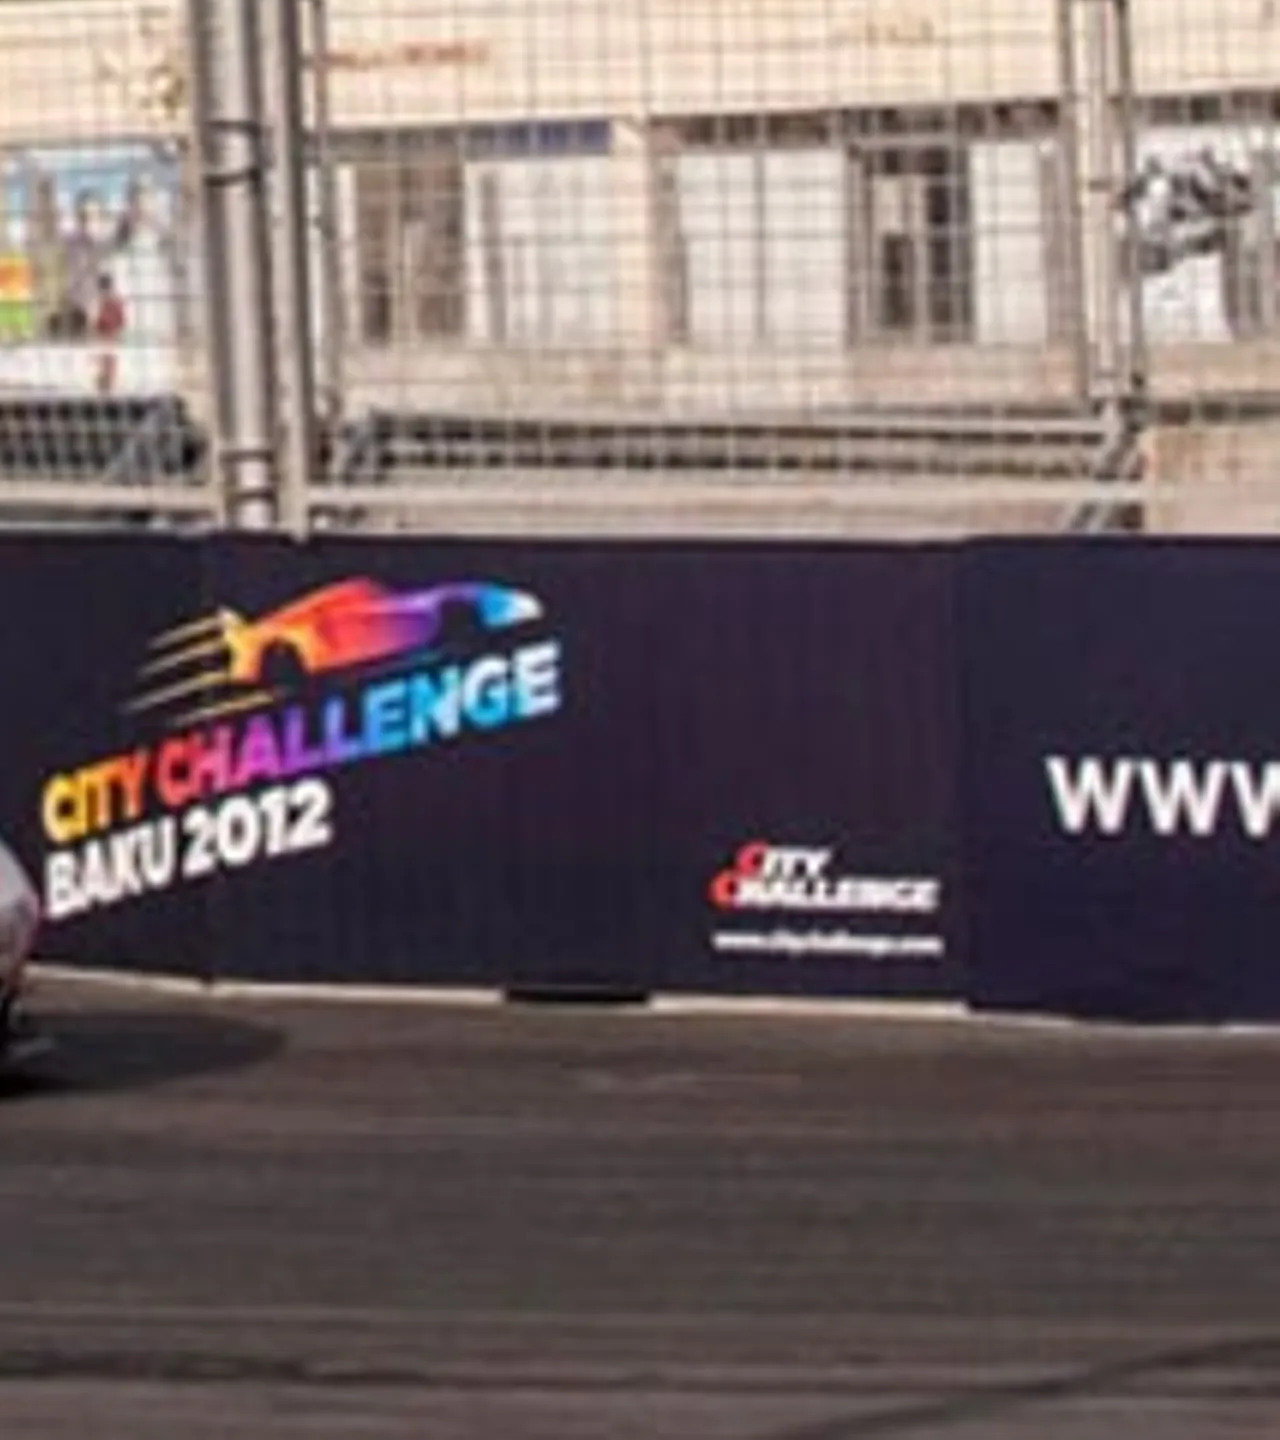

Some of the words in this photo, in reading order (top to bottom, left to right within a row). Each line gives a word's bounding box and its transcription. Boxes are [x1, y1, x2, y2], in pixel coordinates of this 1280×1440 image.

[42, 750, 149, 843] CITY
[154, 640, 562, 808] CHALLENGE
[43, 821, 178, 919] BAKU
[182, 779, 332, 878] 2012
[706, 870, 941, 912] CHALLENGE
